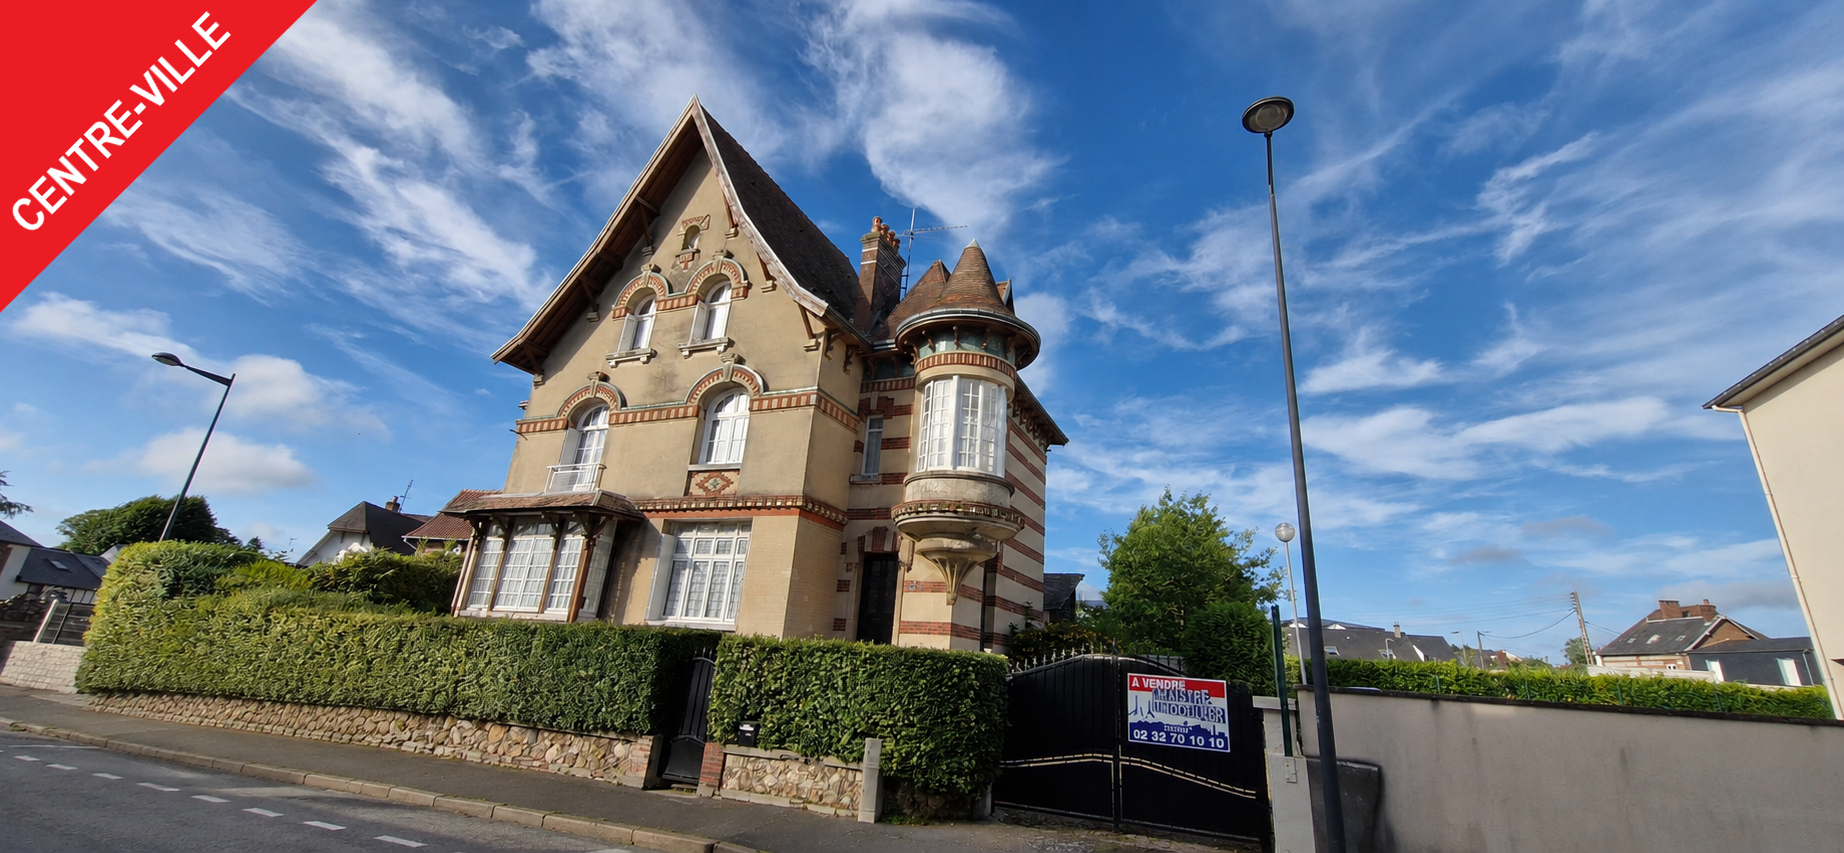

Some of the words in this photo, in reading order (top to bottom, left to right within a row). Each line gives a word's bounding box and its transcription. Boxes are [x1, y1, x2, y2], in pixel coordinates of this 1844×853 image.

[1131, 677, 1140, 688] A
[1142, 677, 1186, 691] VENDRE
[1133, 729, 1148, 740] 02
[1151, 731, 1167, 742] 32
[1170, 733, 1185, 744] 70
[1189, 735, 1205, 746] 10
[1208, 738, 1225, 749] 10
